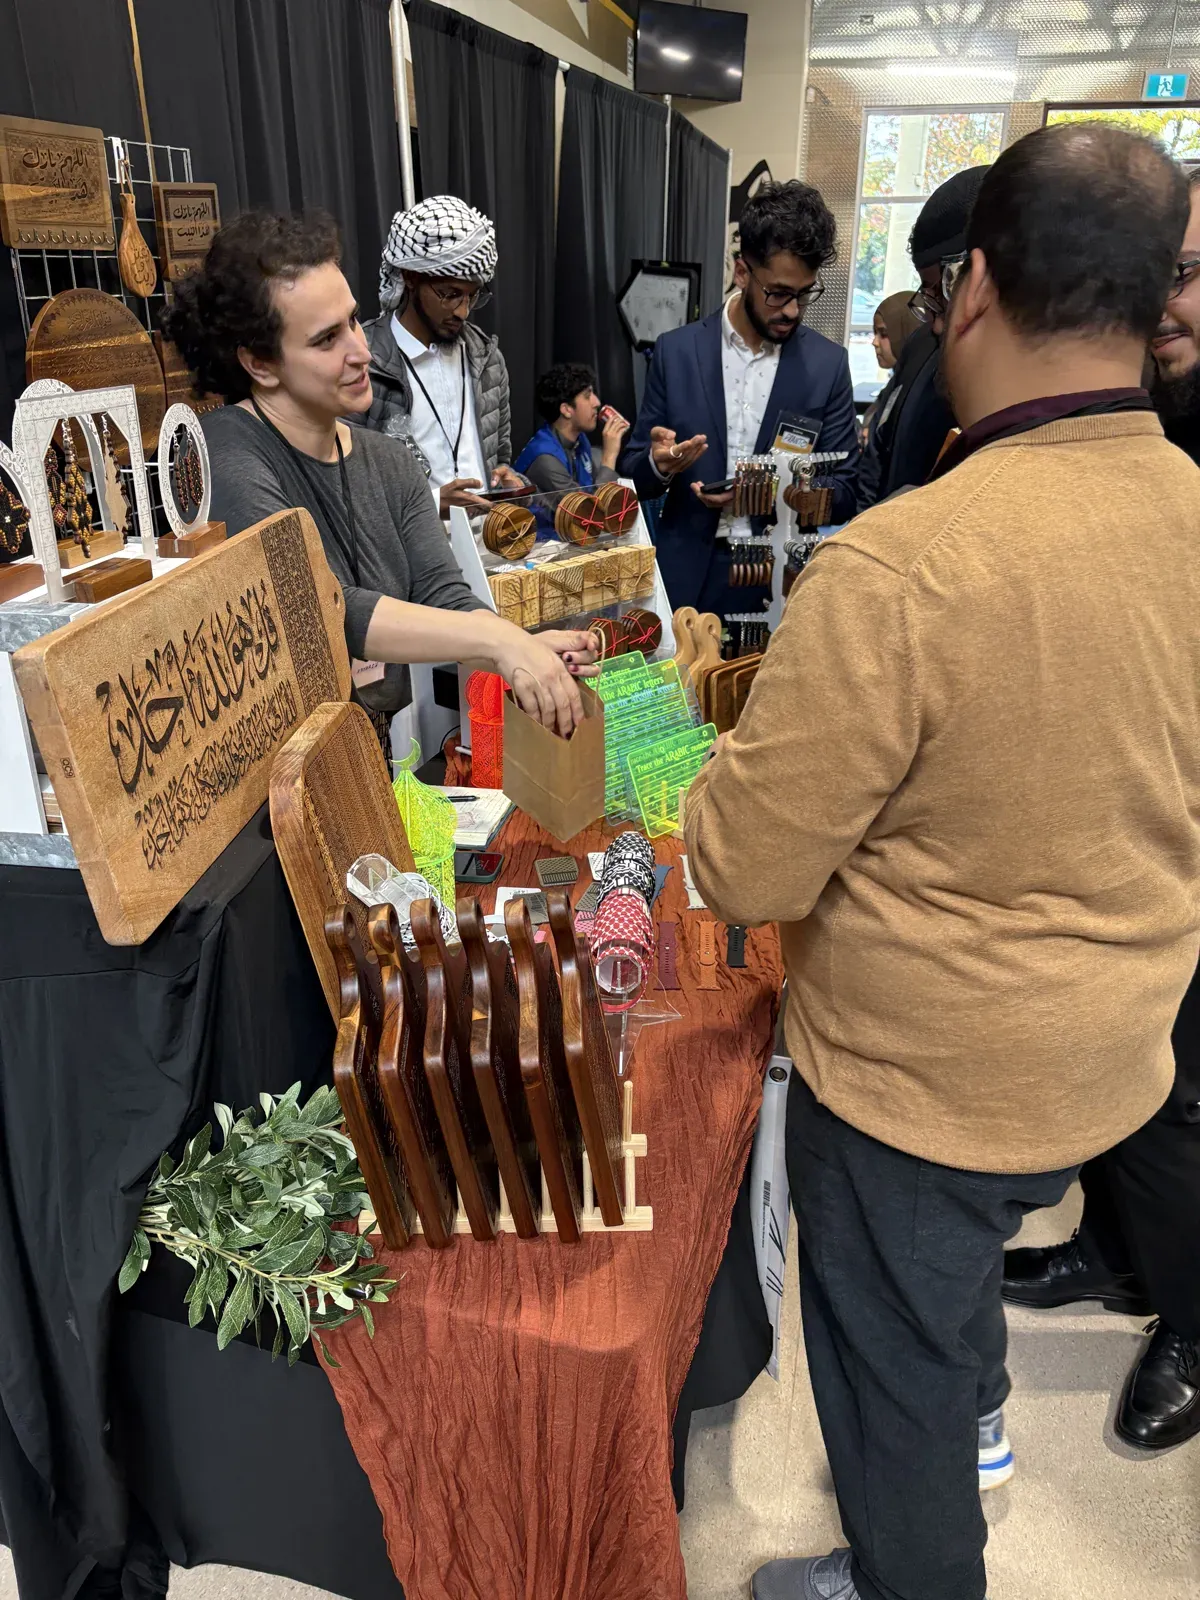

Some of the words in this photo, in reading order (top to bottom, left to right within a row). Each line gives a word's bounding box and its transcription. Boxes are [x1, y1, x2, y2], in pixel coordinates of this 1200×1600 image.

[603, 689, 615, 701] the
[616, 681, 643, 698] ARABIC
[643, 676, 665, 690] letters
[636, 764, 653, 773] Trace
[654, 757, 664, 767] the
[665, 745, 691, 763] ARABIC
[690, 738, 714, 753] numbers
